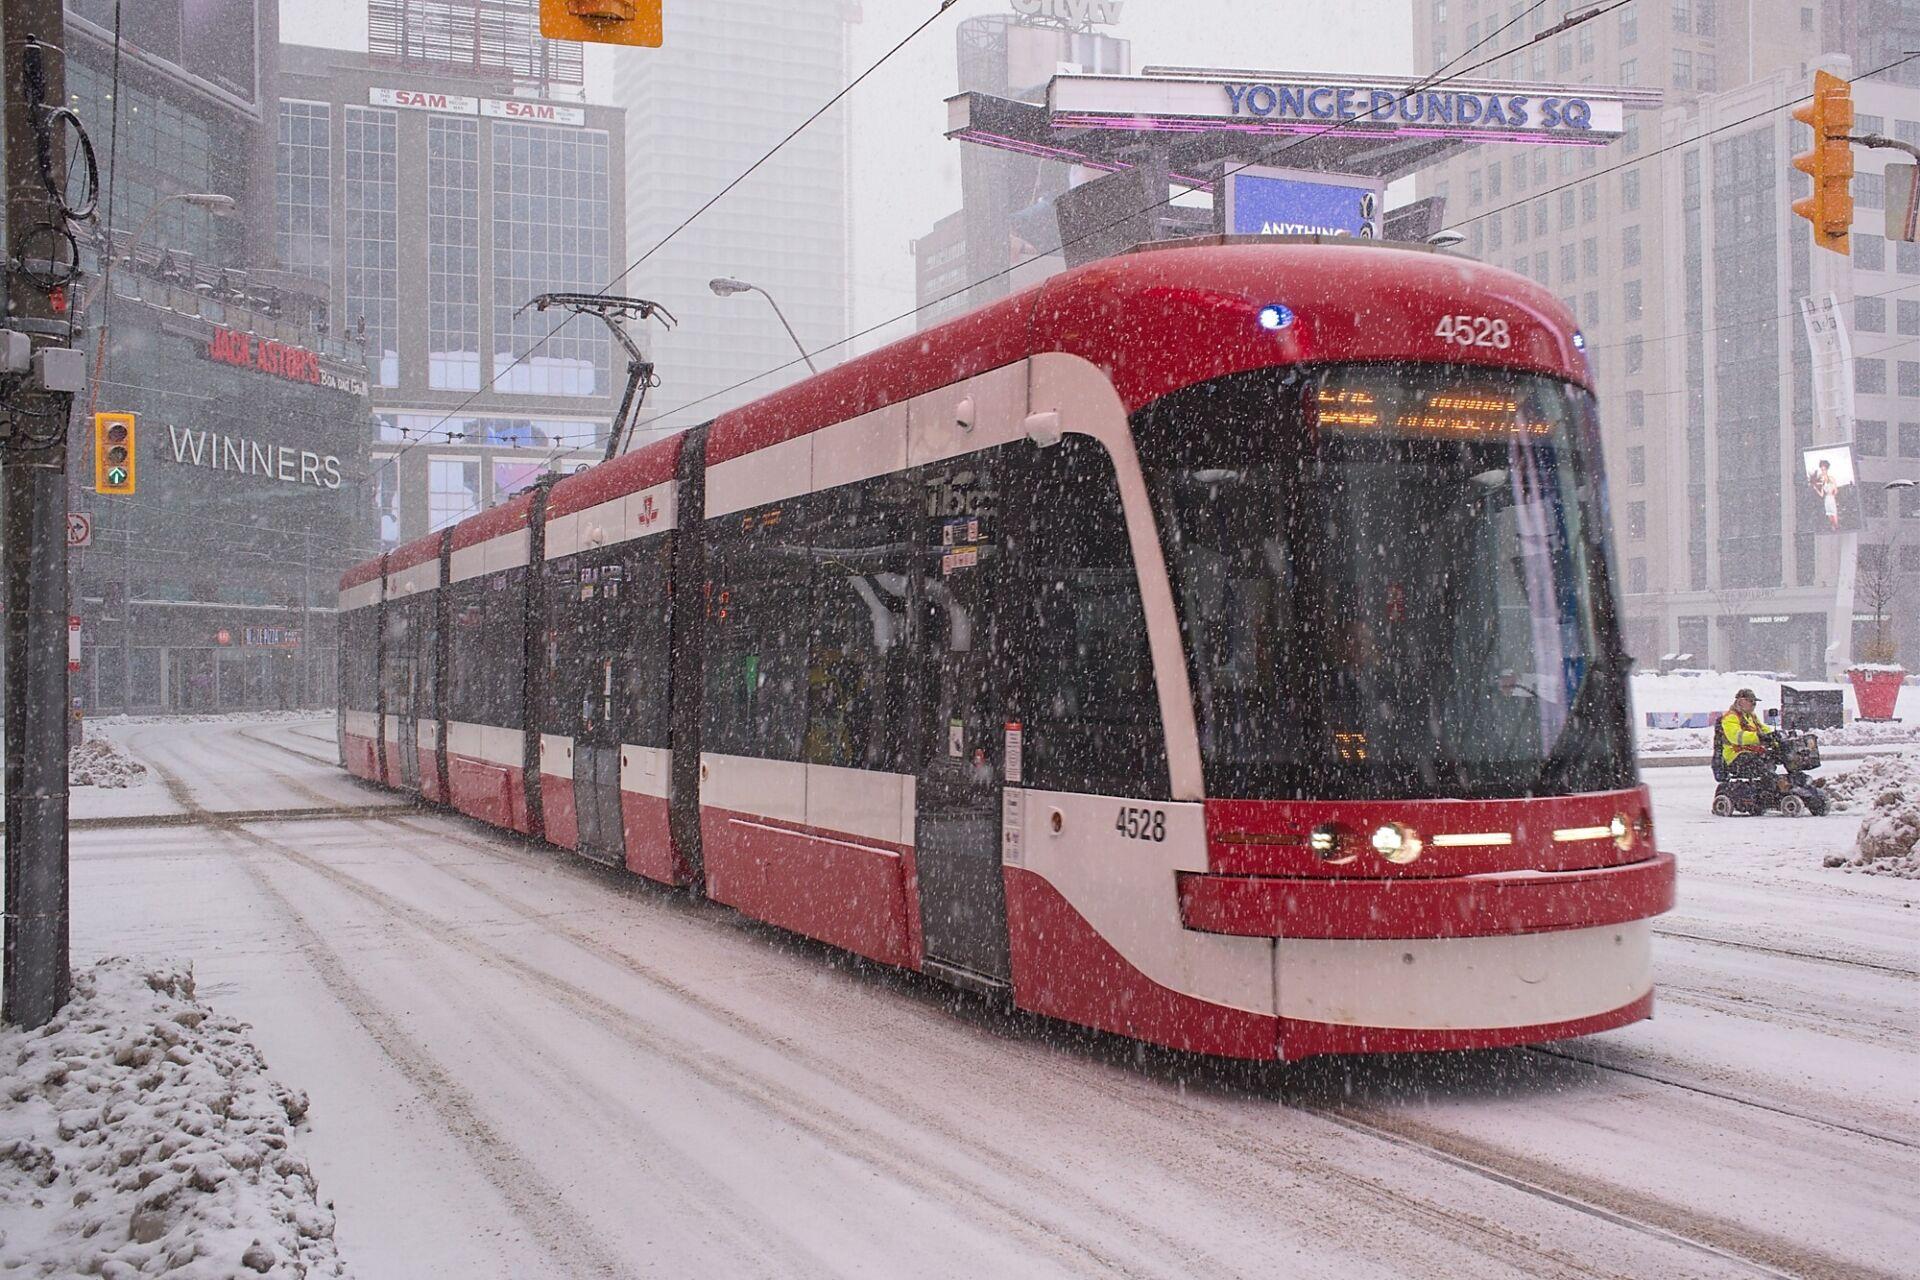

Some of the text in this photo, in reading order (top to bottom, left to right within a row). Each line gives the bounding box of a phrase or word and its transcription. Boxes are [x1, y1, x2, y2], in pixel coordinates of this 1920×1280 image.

[395, 91, 447, 109] SAM
[505, 102, 555, 120] SAM
[1224, 83, 1593, 130] YONGE-DUNDAS SQ
[1261, 221, 1349, 236] ANYTHIN
[208, 326, 253, 367] JACK
[1434, 314, 1512, 350] 4528
[169, 424, 341, 490] WINNERS
[1115, 805, 1166, 843] 4528
